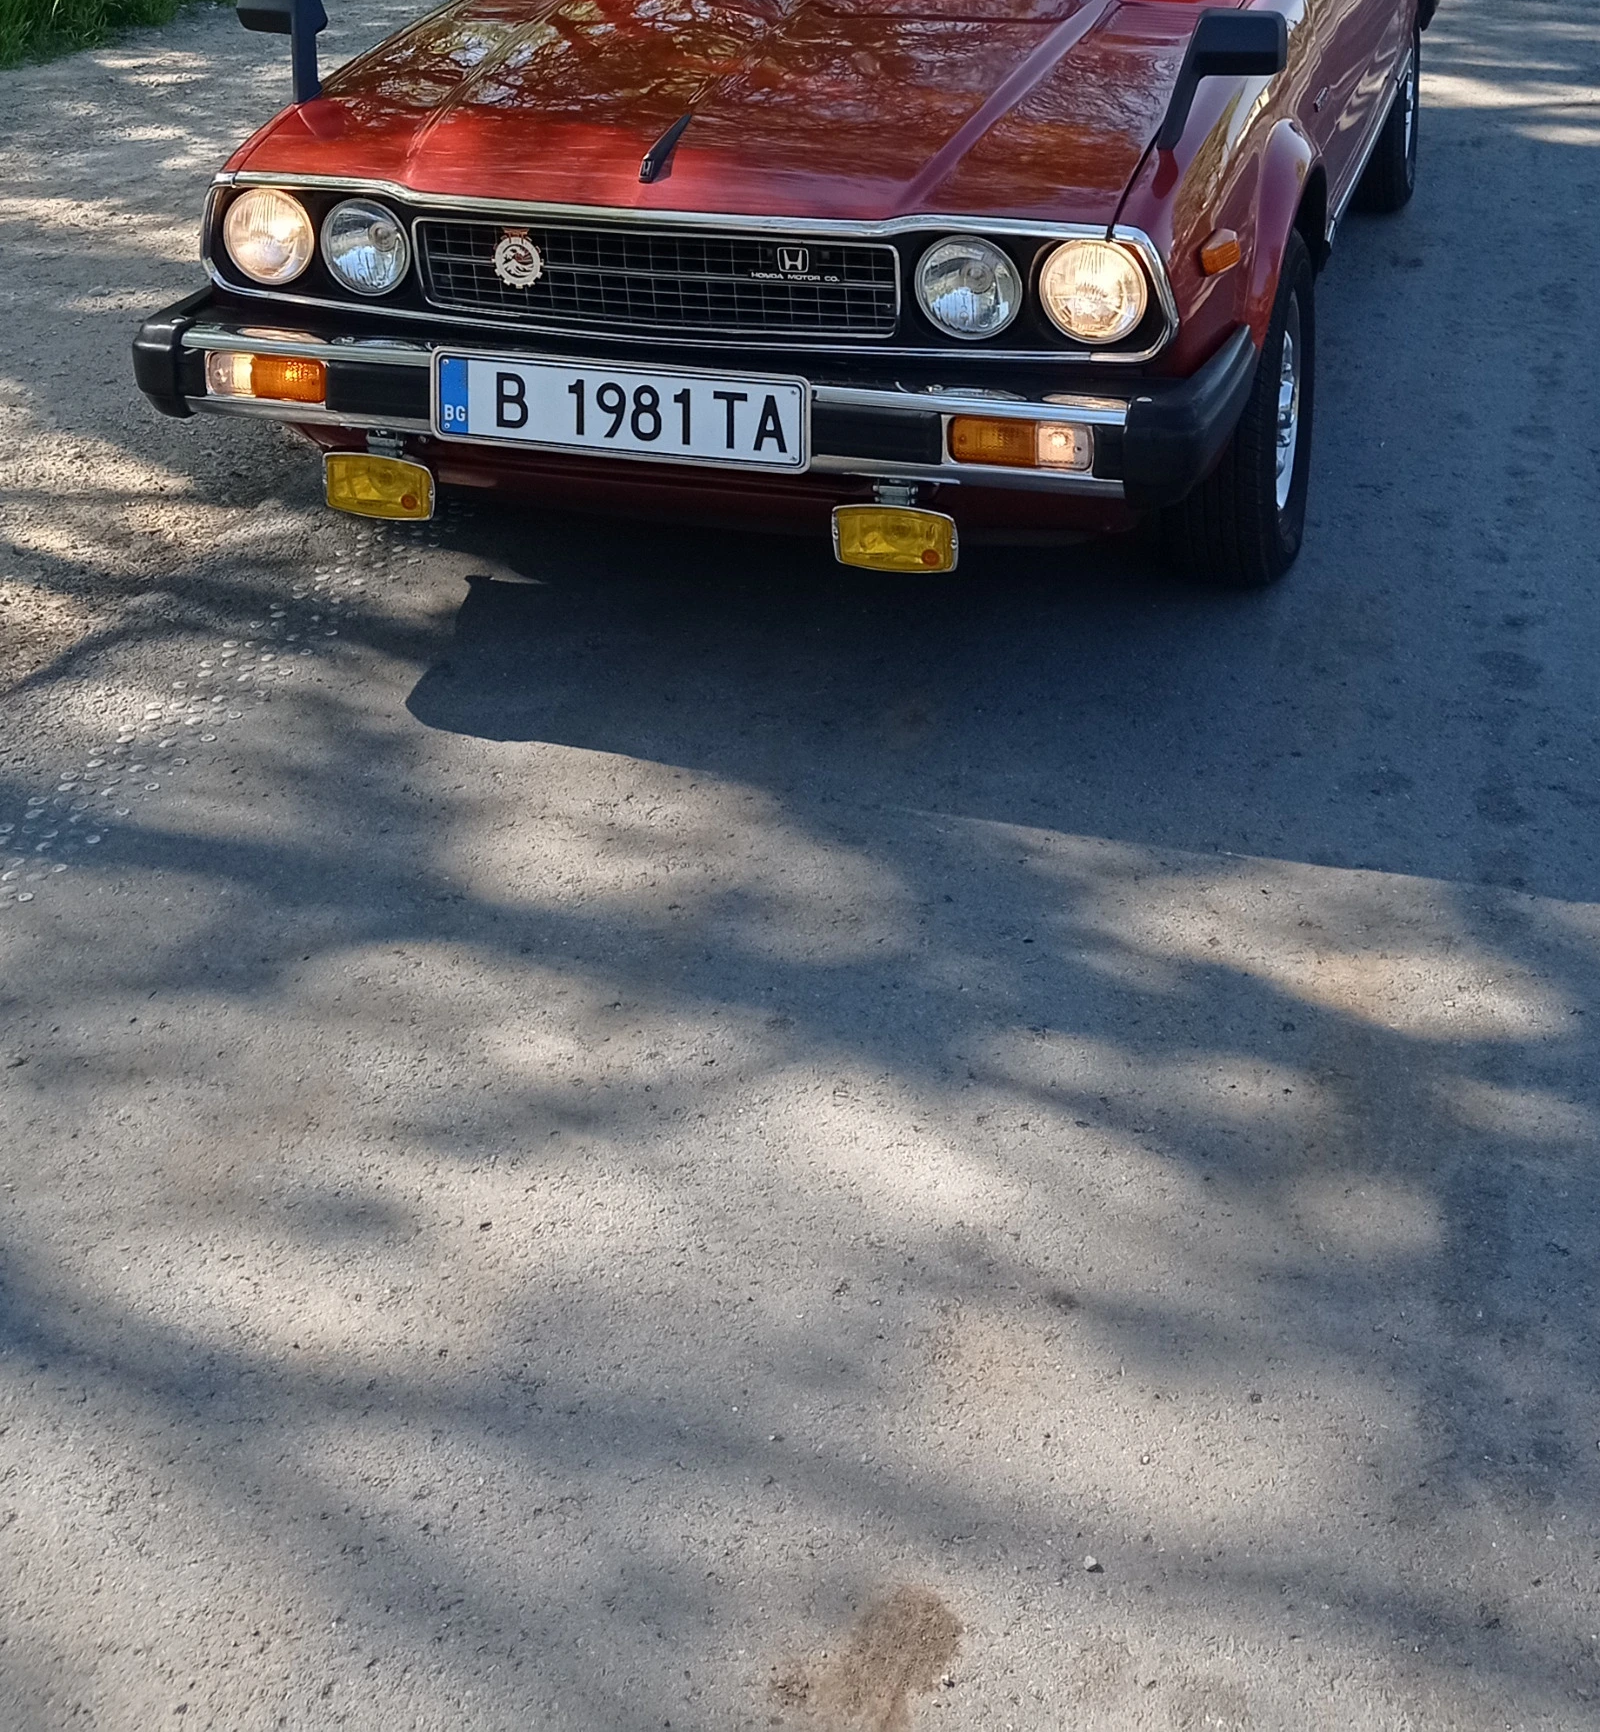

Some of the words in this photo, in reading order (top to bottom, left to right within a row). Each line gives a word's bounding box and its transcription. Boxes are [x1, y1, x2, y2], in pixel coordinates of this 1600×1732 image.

[751, 271, 784, 280] HONDA
[444, 404, 467, 422] BG
[496, 371, 529, 429] B
[567, 378, 691, 446] 1981
[712, 390, 788, 454] TA
